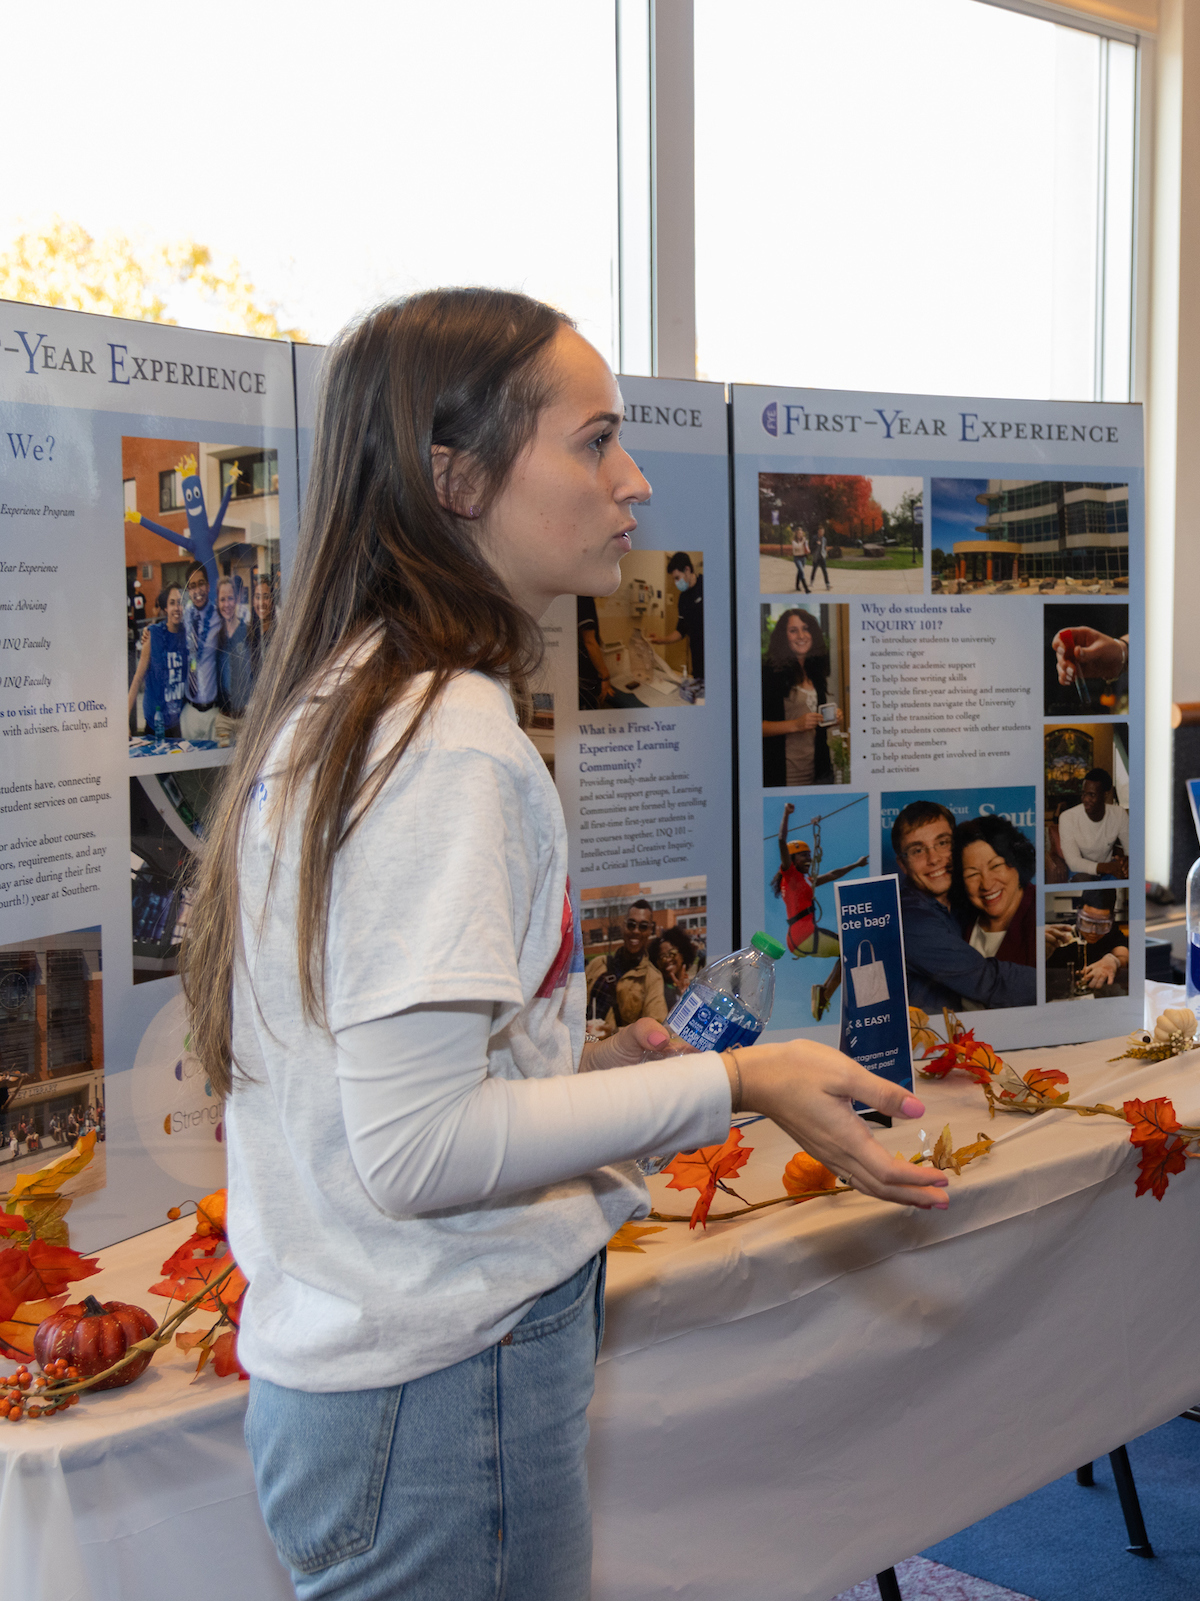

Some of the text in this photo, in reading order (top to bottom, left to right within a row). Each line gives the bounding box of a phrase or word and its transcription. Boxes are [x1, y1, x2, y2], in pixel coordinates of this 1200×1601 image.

[107, 343, 266, 394] EXPERIENCE
[958, 412, 1119, 443] EXPERIENCE
[7, 432, 56, 461] We?
[0, 503, 75, 519] Experience Program
[0, 561, 58, 575] Year Experience
[15, 599, 48, 613] Advising
[861, 602, 972, 616] Why do students take
[861, 620, 943, 632] INQUIRY 101?
[2, 636, 51, 650] INQ Faculty
[870, 635, 996, 644] To introduce students university
[870, 648, 924, 658] academic rigor
[882, 661, 910, 671] provide
[912, 661, 946, 669] academic
[948, 661, 976, 671] support
[3, 674, 51, 689] INQ Faculty
[870, 674, 967, 684] To help hone writing skills
[870, 685, 1031, 698] To provide first-year advising and mentoring
[18, 699, 107, 715] visit the FYE Office,
[871, 699, 1016, 711] To help students navigate the University
[871, 712, 980, 722] To aid the transition college
[2, 724, 22, 737] with
[93, 717, 108, 728] and
[578, 720, 677, 736] What is First-Year
[871, 723, 1031, 737] To help students connect with other students
[579, 738, 681, 756] Experience Learning
[871, 738, 947, 749] and faculty members
[871, 750, 1010, 763] To help students get involved events
[579, 758, 643, 773] Community?
[871, 765, 920, 774] and activities
[34, 774, 102, 790] have, connecting
[579, 772, 690, 788] Providing ready-made academic
[579, 784, 703, 801] and social support Learning
[0, 791, 112, 813] student services on campus.
[580, 804, 627, 816] Communities
[641, 800, 666, 810] formed
[667, 800, 676, 810] by
[677, 797, 707, 807] enrolling
[590, 813, 686, 829] first-time first-year students
[10, 836, 37, 850] advice
[39, 832, 63, 846] about
[596, 827, 673, 843] courses INQ
[18, 845, 107, 869] requirements, and any
[580, 843, 666, 858] Intellectual and Creative
[580, 856, 661, 873] and Critical Thinking
[13, 862, 102, 887] arise during their first
[31, 881, 100, 906] year Southern.
[841, 902, 873, 916] FREE
[864, 913, 891, 928] bag?
[864, 1014, 891, 1027] EASY!
[885, 1047, 899, 1056] and
[878, 1058, 896, 1070] post!
